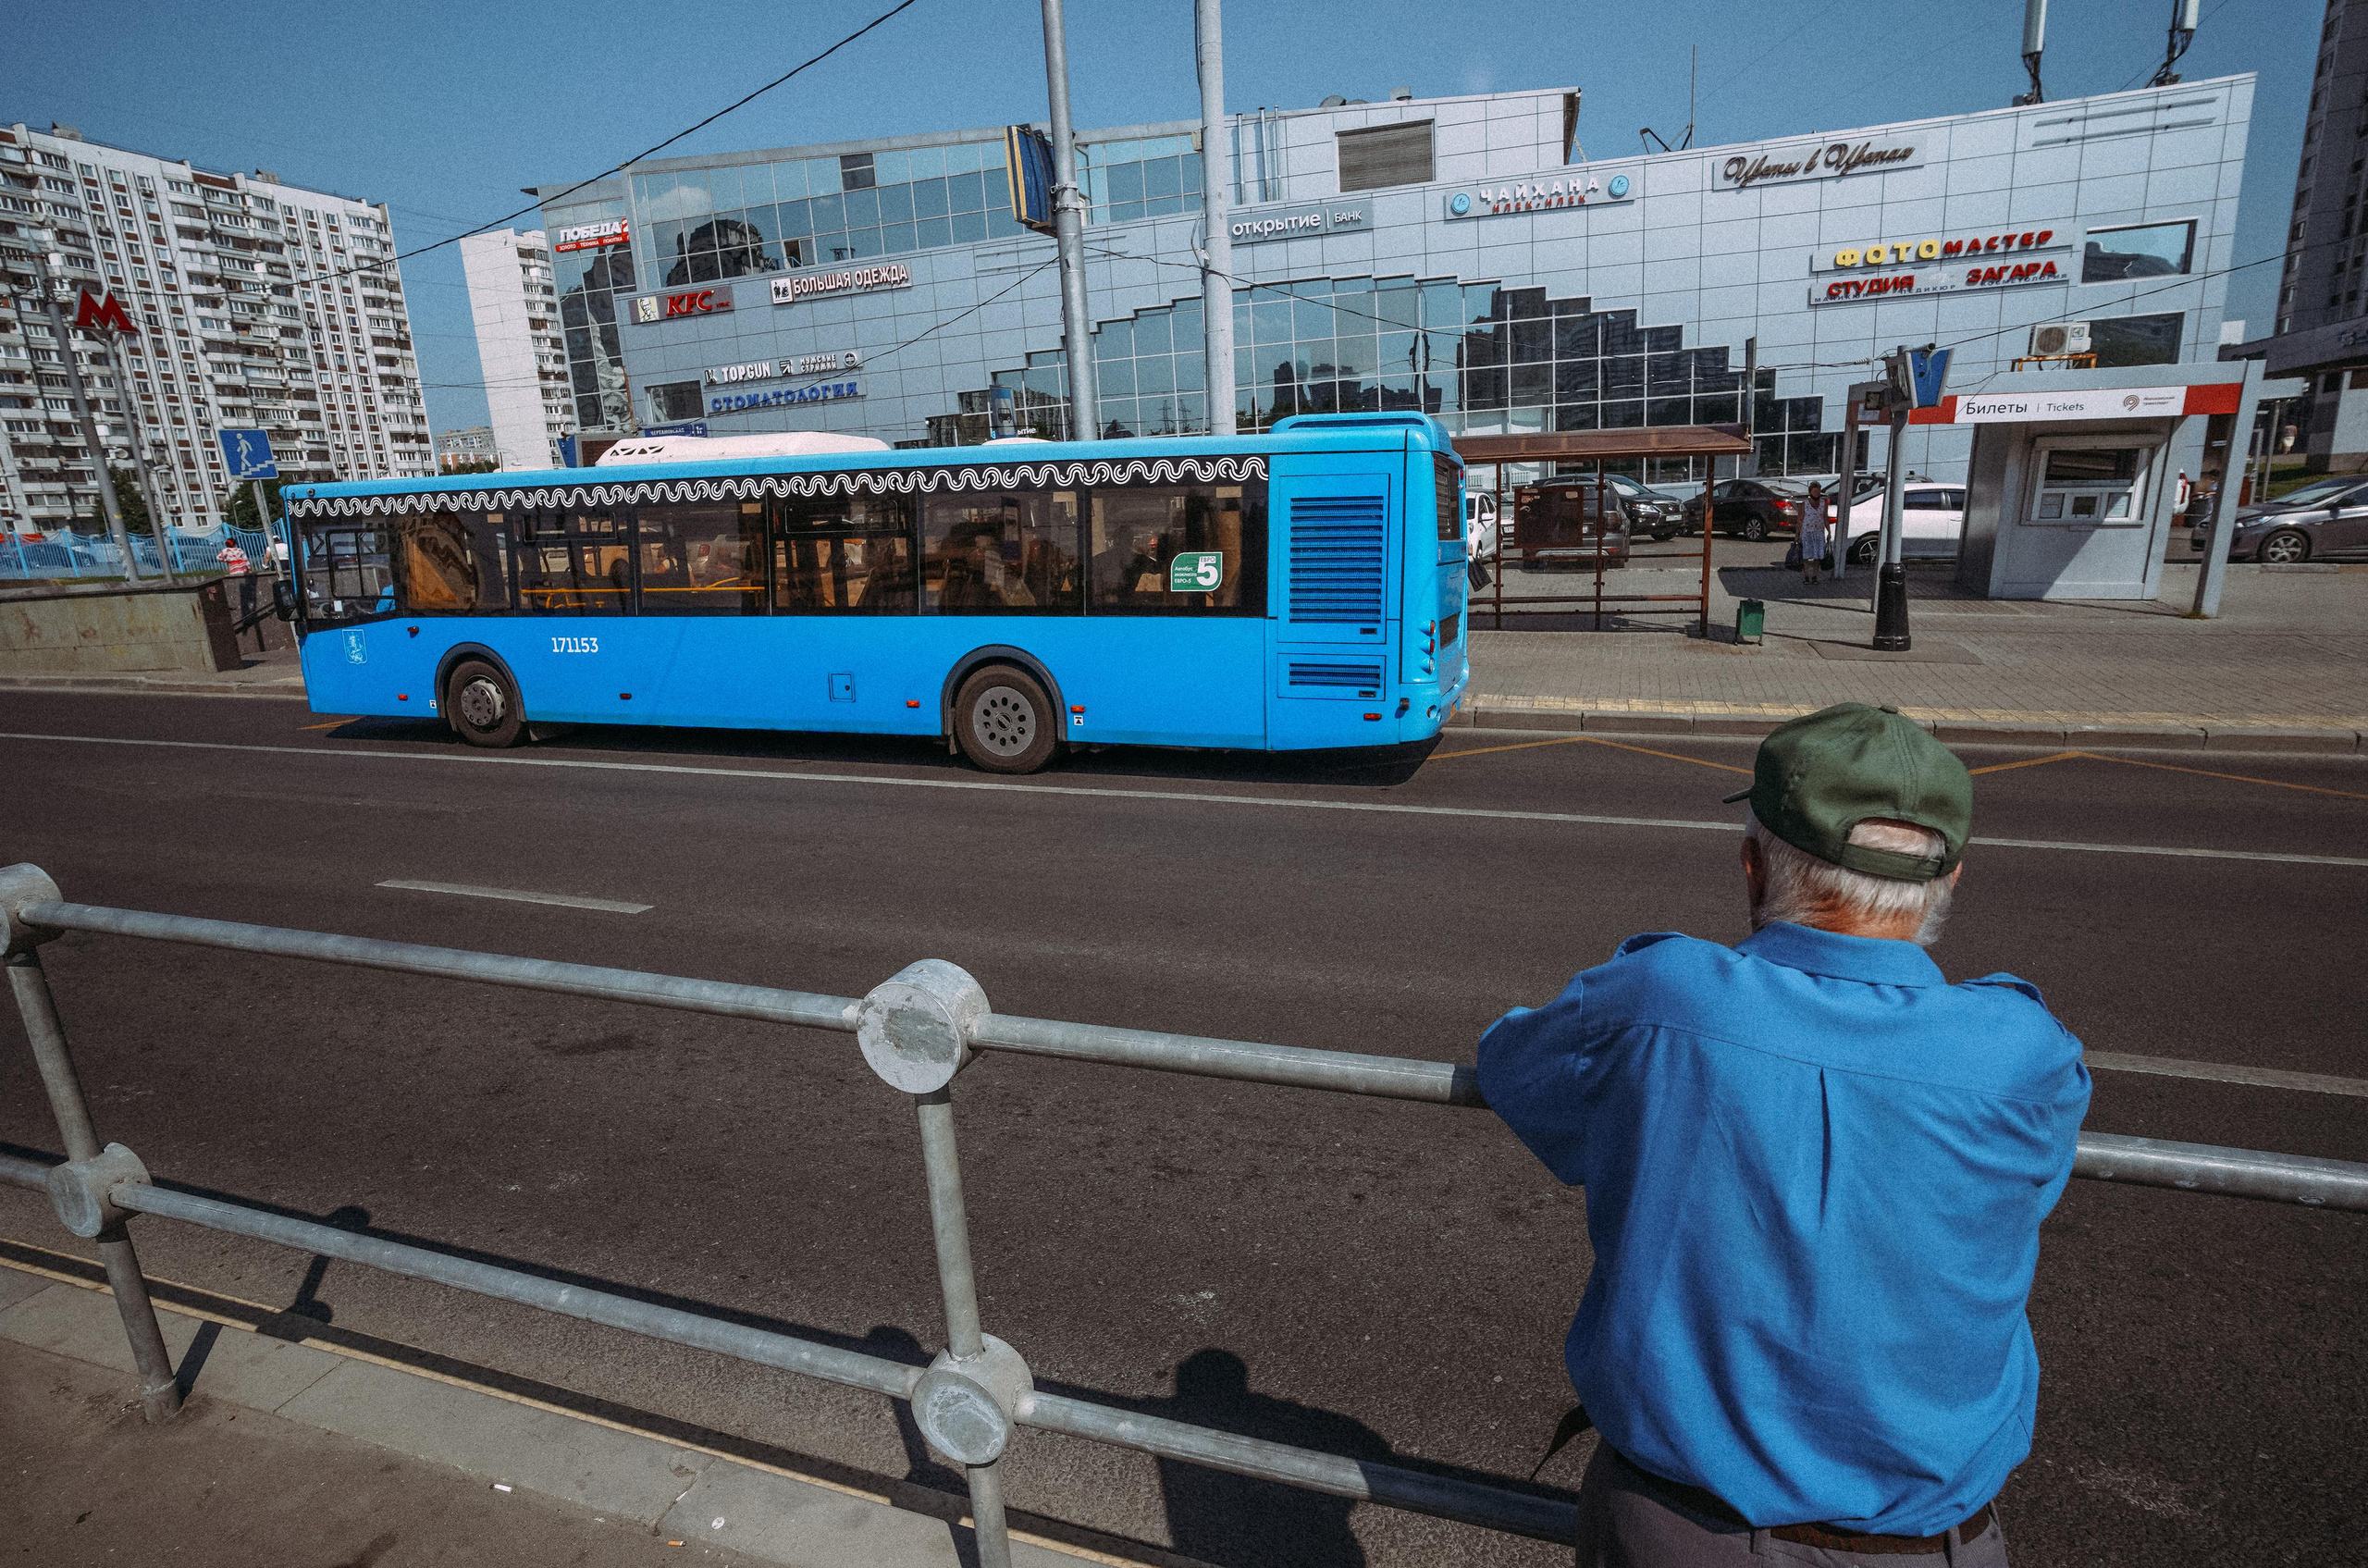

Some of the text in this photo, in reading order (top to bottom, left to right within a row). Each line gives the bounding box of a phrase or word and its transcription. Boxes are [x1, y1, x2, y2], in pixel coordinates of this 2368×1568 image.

[1723, 154, 1803, 188] Цветы
[1803, 148, 1822, 171] в
[1480, 177, 1599, 203] ЧАЙХАНА
[560, 222, 622, 242] ПОБЕДА
[1232, 209, 1363, 237] открытие БАНК
[794, 264, 909, 295] БОЛЬШАЯ ОДЕЖДА
[1828, 261, 2057, 296] СТУДИЯ ЗАГАРА
[666, 290, 713, 316] KFC
[800, 353, 836, 364] МУЖСКИЕ
[801, 364, 837, 373] СТРИЖКИ
[722, 362, 771, 382] TOPGUN
[711, 381, 858, 411] СТОМАТОЛОГИЯ
[1967, 401, 2028, 414] Билеты
[2047, 402, 2084, 412] Tickets
[551, 637, 598, 652] 171153
